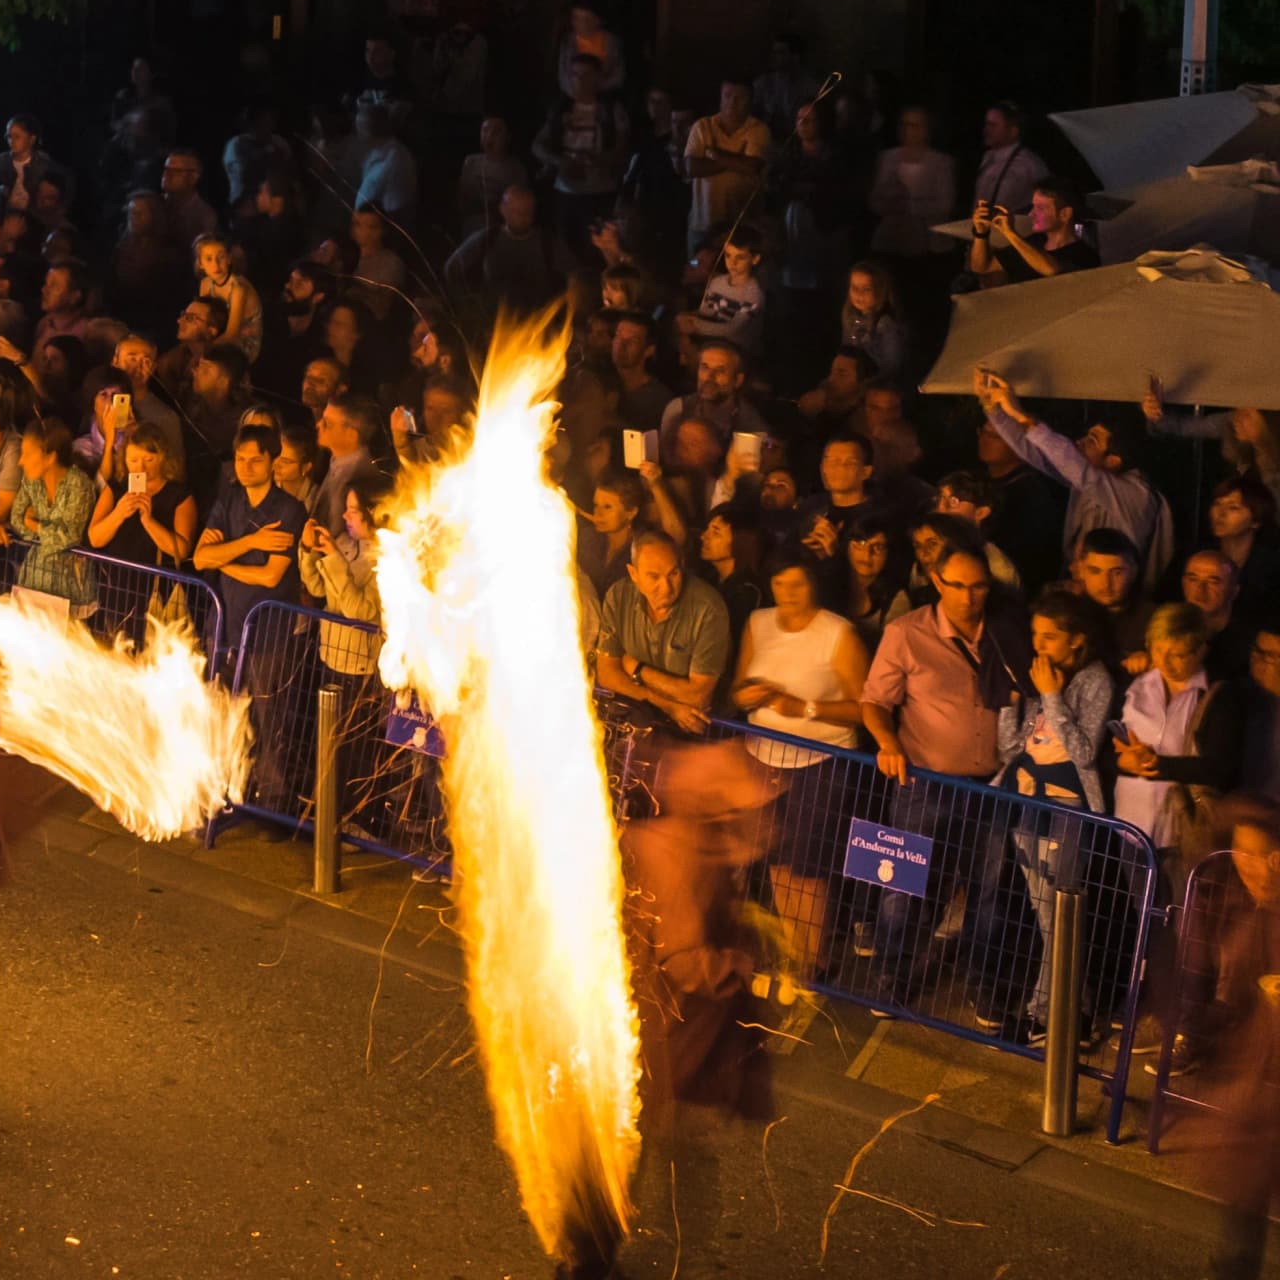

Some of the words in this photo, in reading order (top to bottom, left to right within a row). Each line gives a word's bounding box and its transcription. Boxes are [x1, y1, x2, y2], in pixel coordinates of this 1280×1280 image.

[877, 831, 905, 845] Comú
[852, 837, 895, 856] d'Andorra
[896, 848, 904, 859] la
[906, 852, 927, 865] Vella
